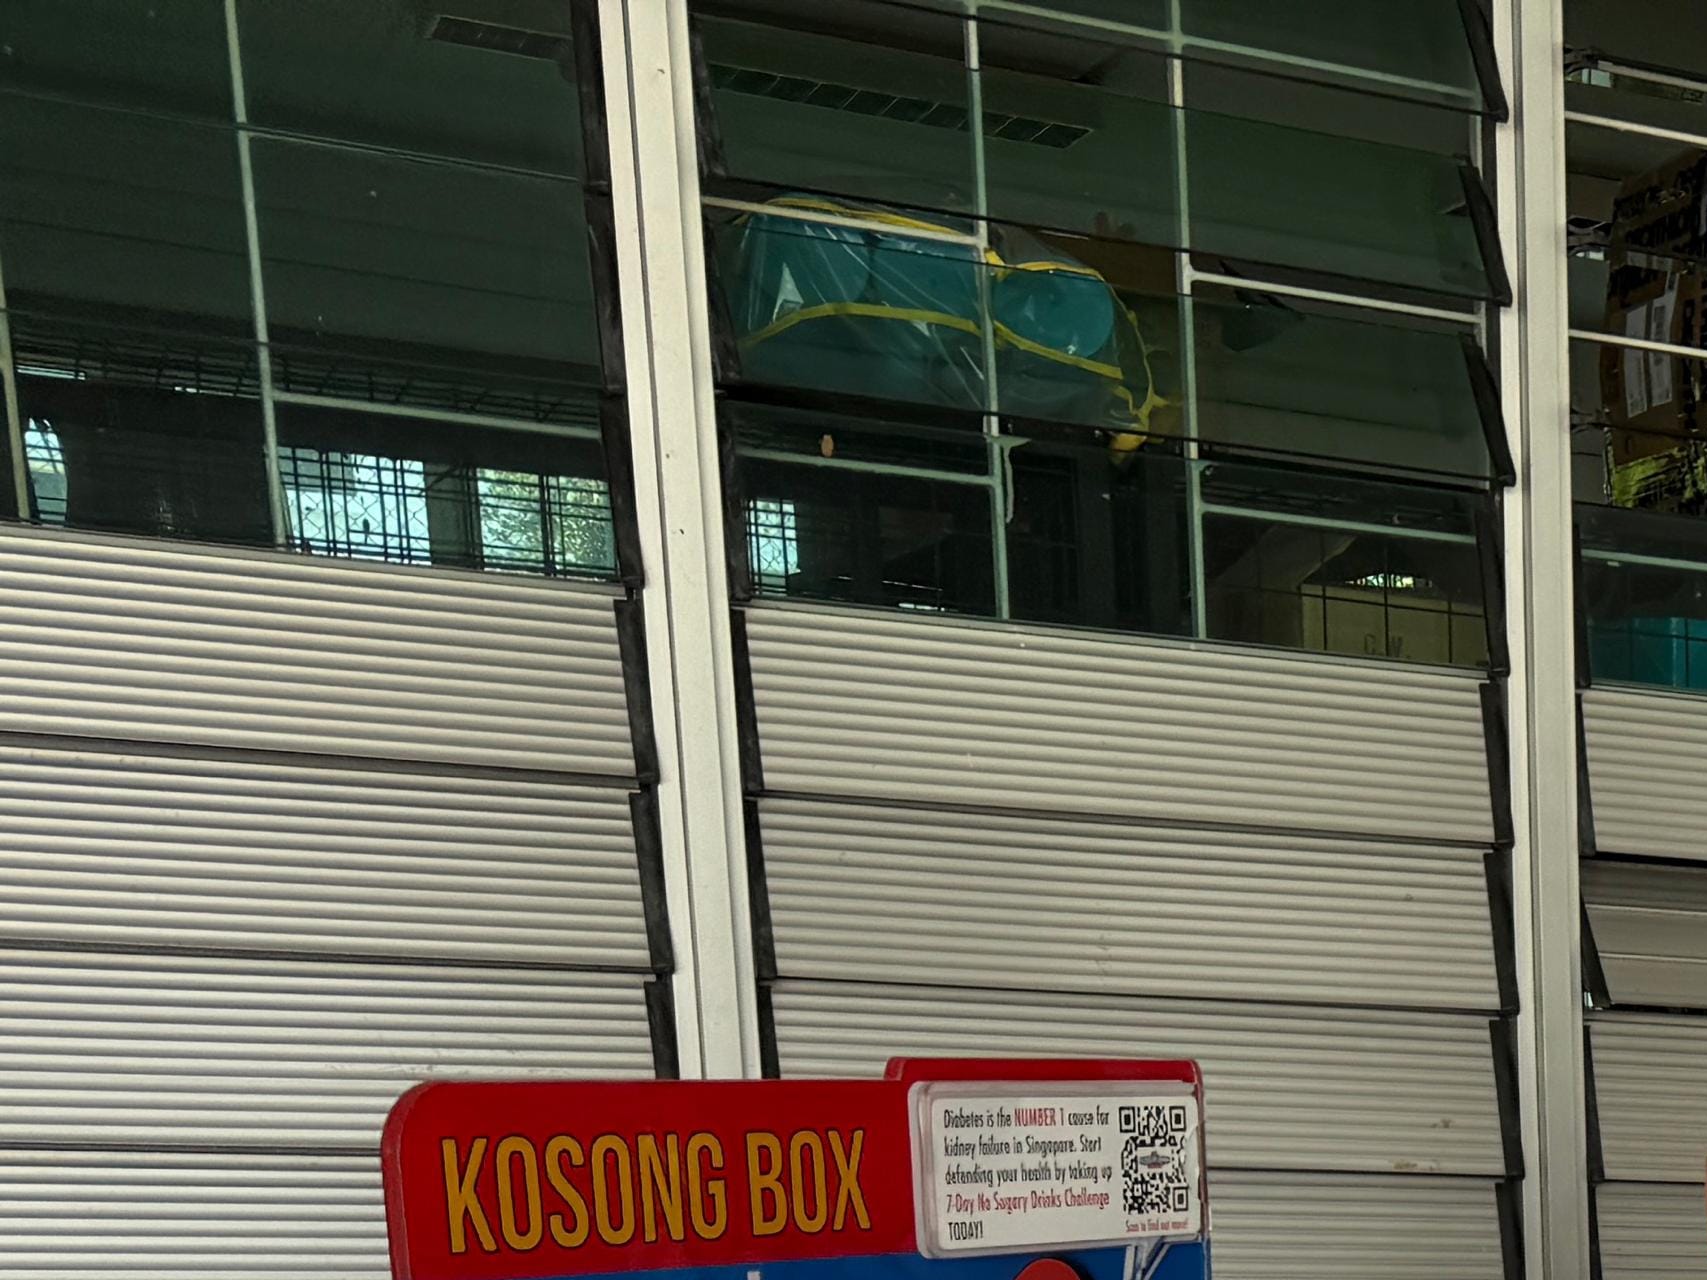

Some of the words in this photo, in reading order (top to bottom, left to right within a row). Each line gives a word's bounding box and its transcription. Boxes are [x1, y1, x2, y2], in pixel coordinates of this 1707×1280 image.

[944, 1109, 984, 1129] Diabetes
[986, 1110, 995, 1128] is
[997, 1107, 1012, 1127] the
[1014, 1108, 1057, 1127] NUMBER
[1068, 1112, 1094, 1126] cause
[1096, 1105, 1109, 1126] for
[944, 1136, 976, 1160] kidney
[979, 1134, 1010, 1156] failure
[1013, 1137, 1023, 1154] in
[1025, 1135, 1077, 1158] Singapore.
[945, 1163, 994, 1187] defending
[996, 1165, 1018, 1186] your
[1020, 1160, 1051, 1181] health
[1054, 1160, 1066, 1184] by
[1069, 1161, 1099, 1183] taking
[1101, 1168, 1113, 1184] up
[441, 1132, 729, 1254] KOSONG
[746, 1129, 871, 1237] BOX
[946, 1193, 974, 1216] 7-Day
[993, 1190, 1028, 1215] Sugary
[1031, 1187, 1061, 1209] Drinks
[1065, 1186, 1110, 1213] Challenge
[948, 1221, 983, 1241] TODAY!
